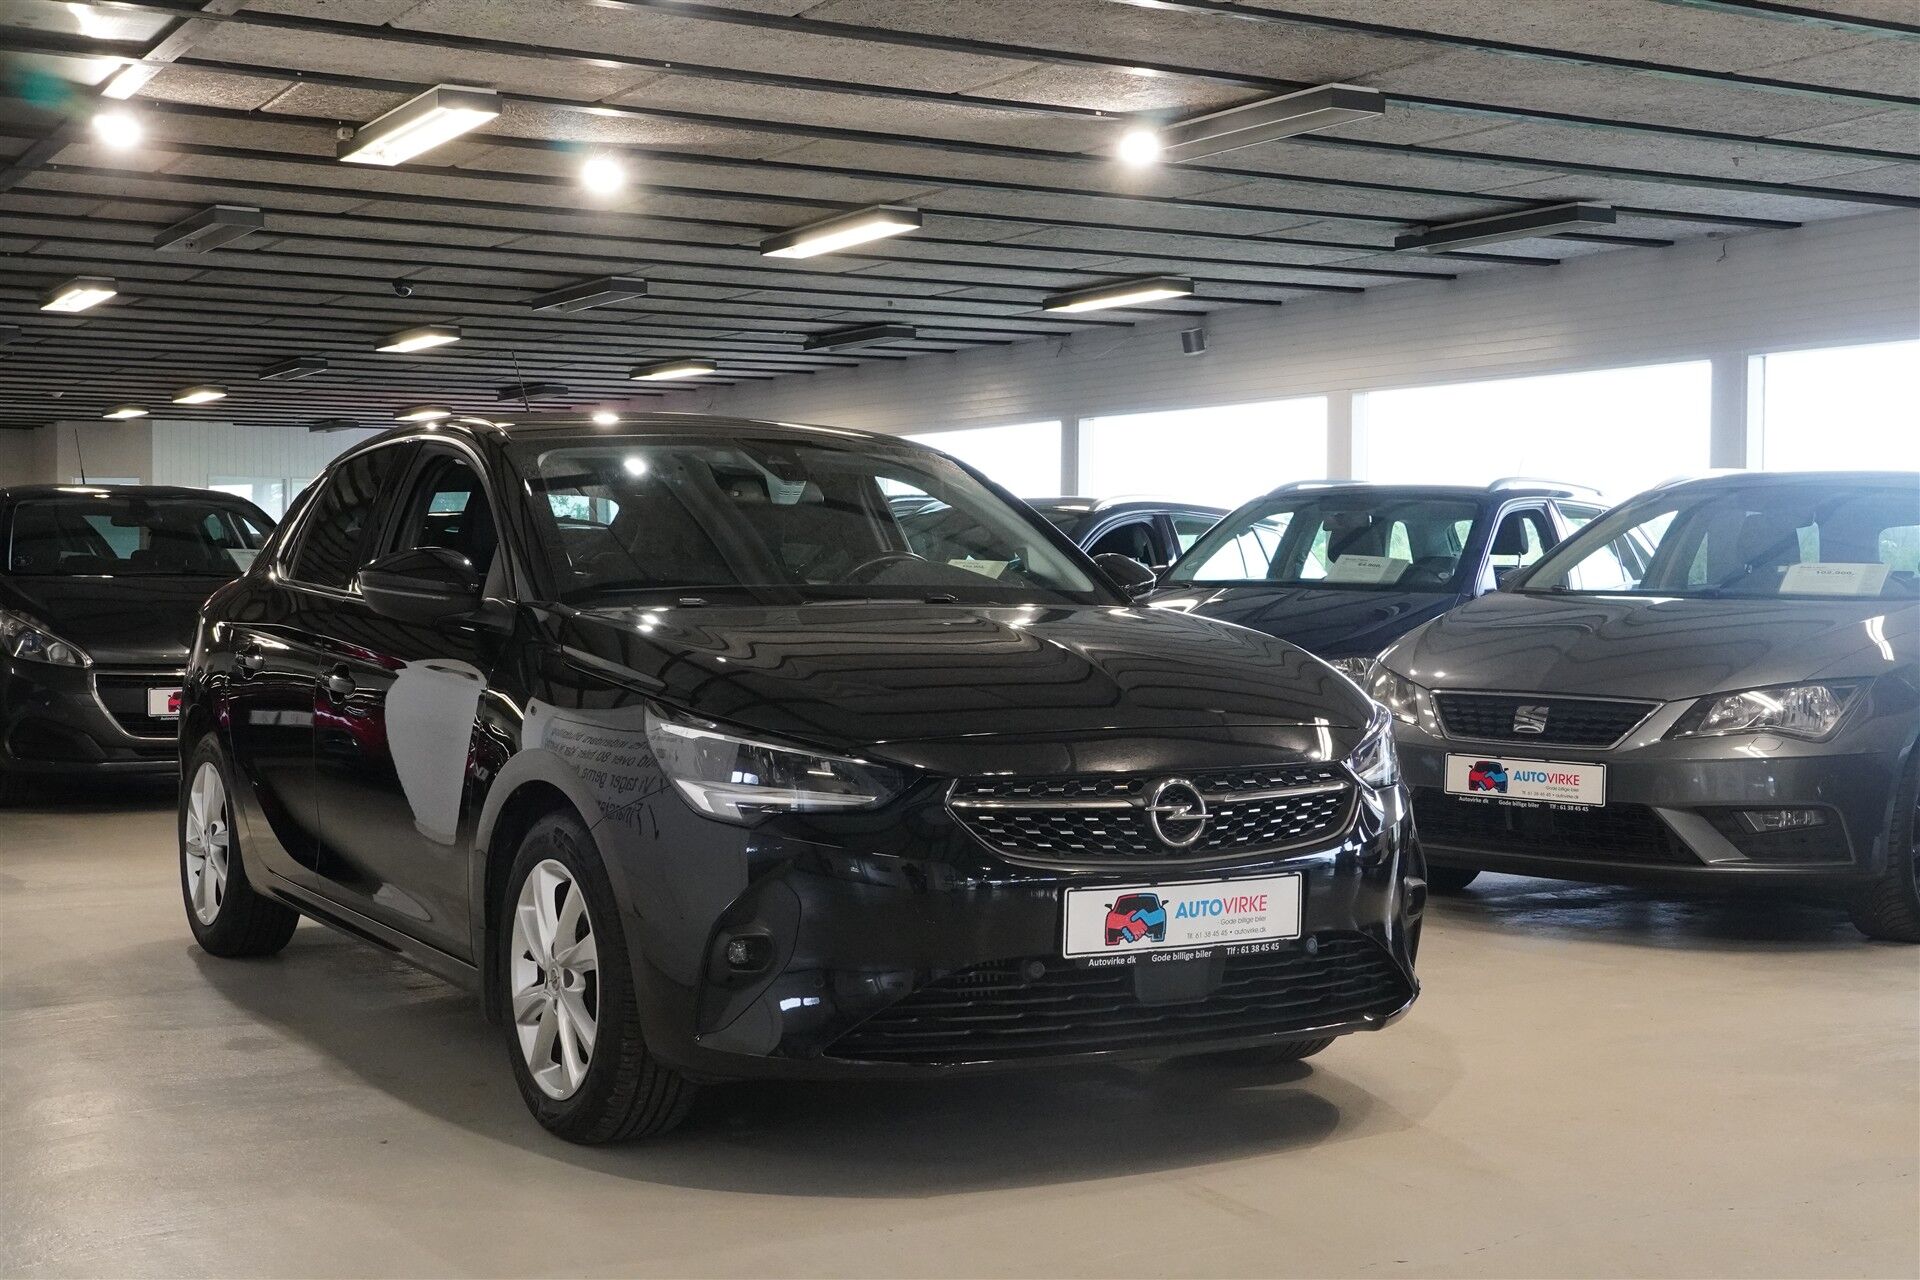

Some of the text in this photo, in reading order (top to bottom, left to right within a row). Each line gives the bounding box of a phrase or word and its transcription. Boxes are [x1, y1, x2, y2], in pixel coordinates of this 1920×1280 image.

[1514, 770, 1580, 786] AUTOVIRKE
[1498, 799, 1511, 807] Gode
[1512, 800, 1528, 809] billige
[1175, 894, 1268, 919] AUTOVIRKE
[1088, 956, 1125, 967] Autovirke
[1126, 955, 1137, 964] dk
[1151, 953, 1171, 962] Gode
[1172, 951, 1194, 962] billige
[1195, 949, 1212, 959] biler
[1240, 945, 1249, 954] 61
[1250, 944, 1260, 953] 38
[1260, 943, 1270, 952] 45
[1270, 942, 1280, 951] 45
